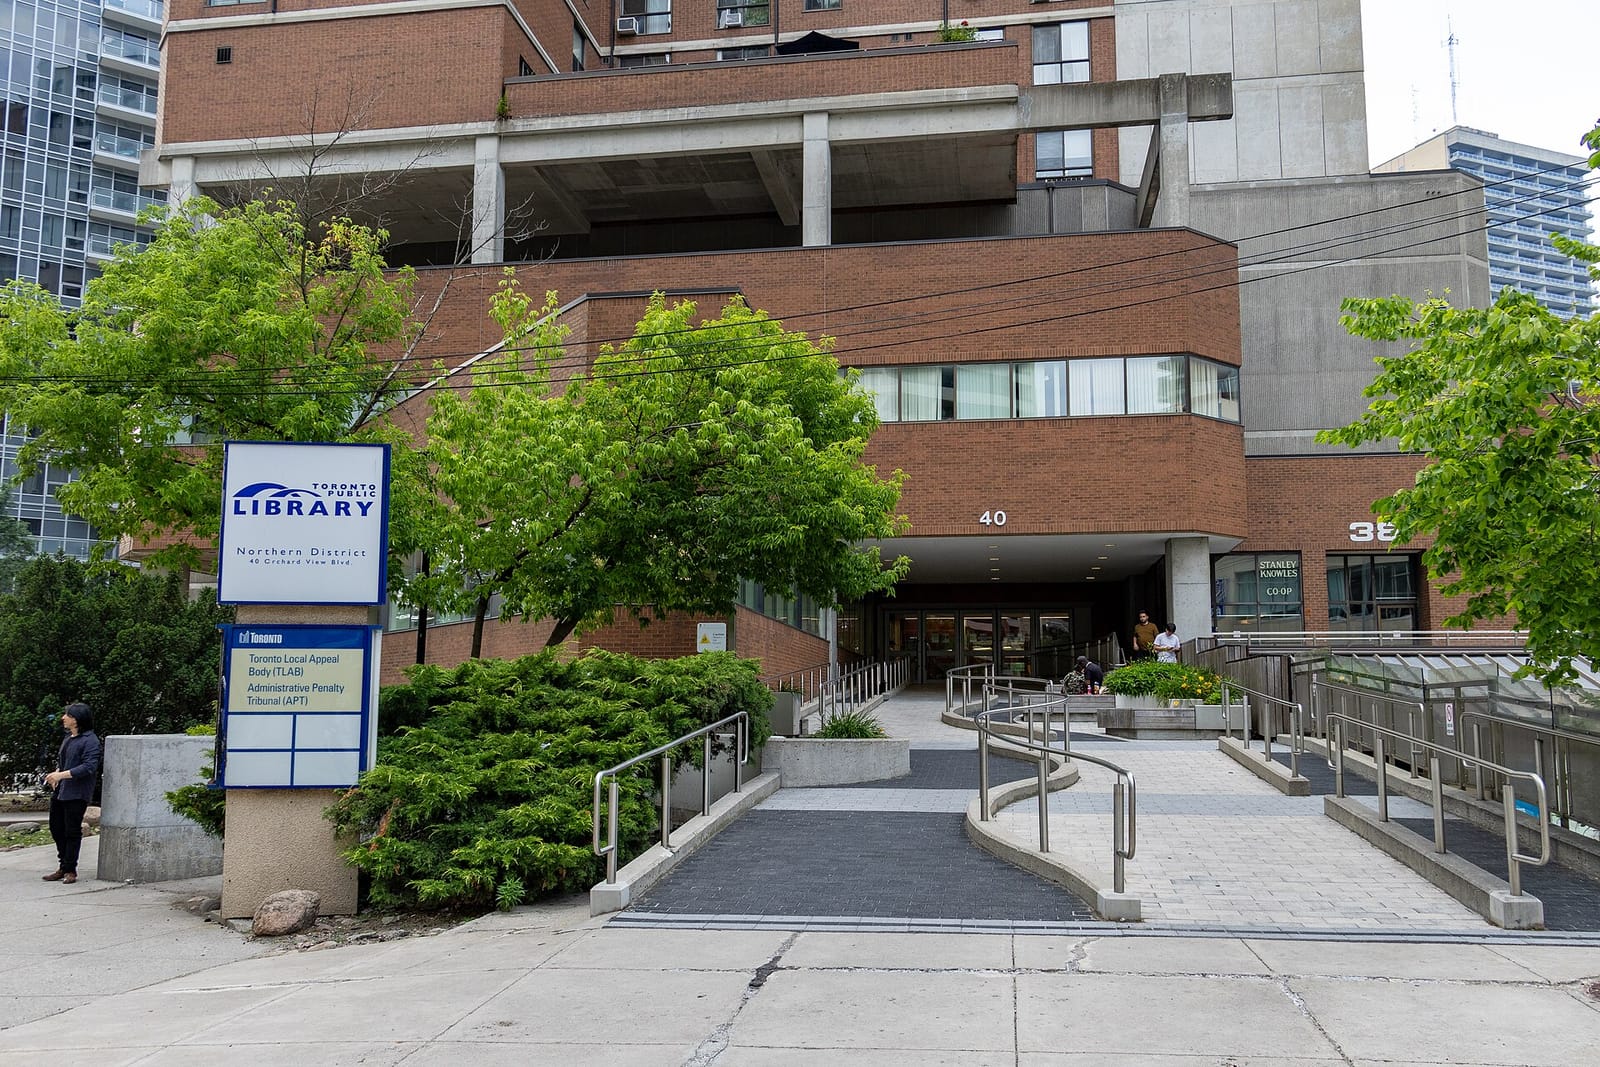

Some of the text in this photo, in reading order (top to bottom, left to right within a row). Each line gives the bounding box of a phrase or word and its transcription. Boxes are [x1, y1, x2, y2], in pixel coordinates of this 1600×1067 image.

[233, 500, 374, 516] LIBRARY
[980, 510, 1007, 526] 40
[1349, 522, 1398, 542] 38
[236, 547, 366, 557] Northern District
[1260, 560, 1297, 569] STANLEY
[1260, 570, 1298, 578] KNOWLES
[250, 632, 283, 644] TORONTO
[249, 654, 340, 665] Toronto Local Appeal
[248, 666, 304, 678] Body (TLAB)
[247, 683, 344, 694] Administrative Penalty
[246, 696, 308, 706] Tribunal (APT)
